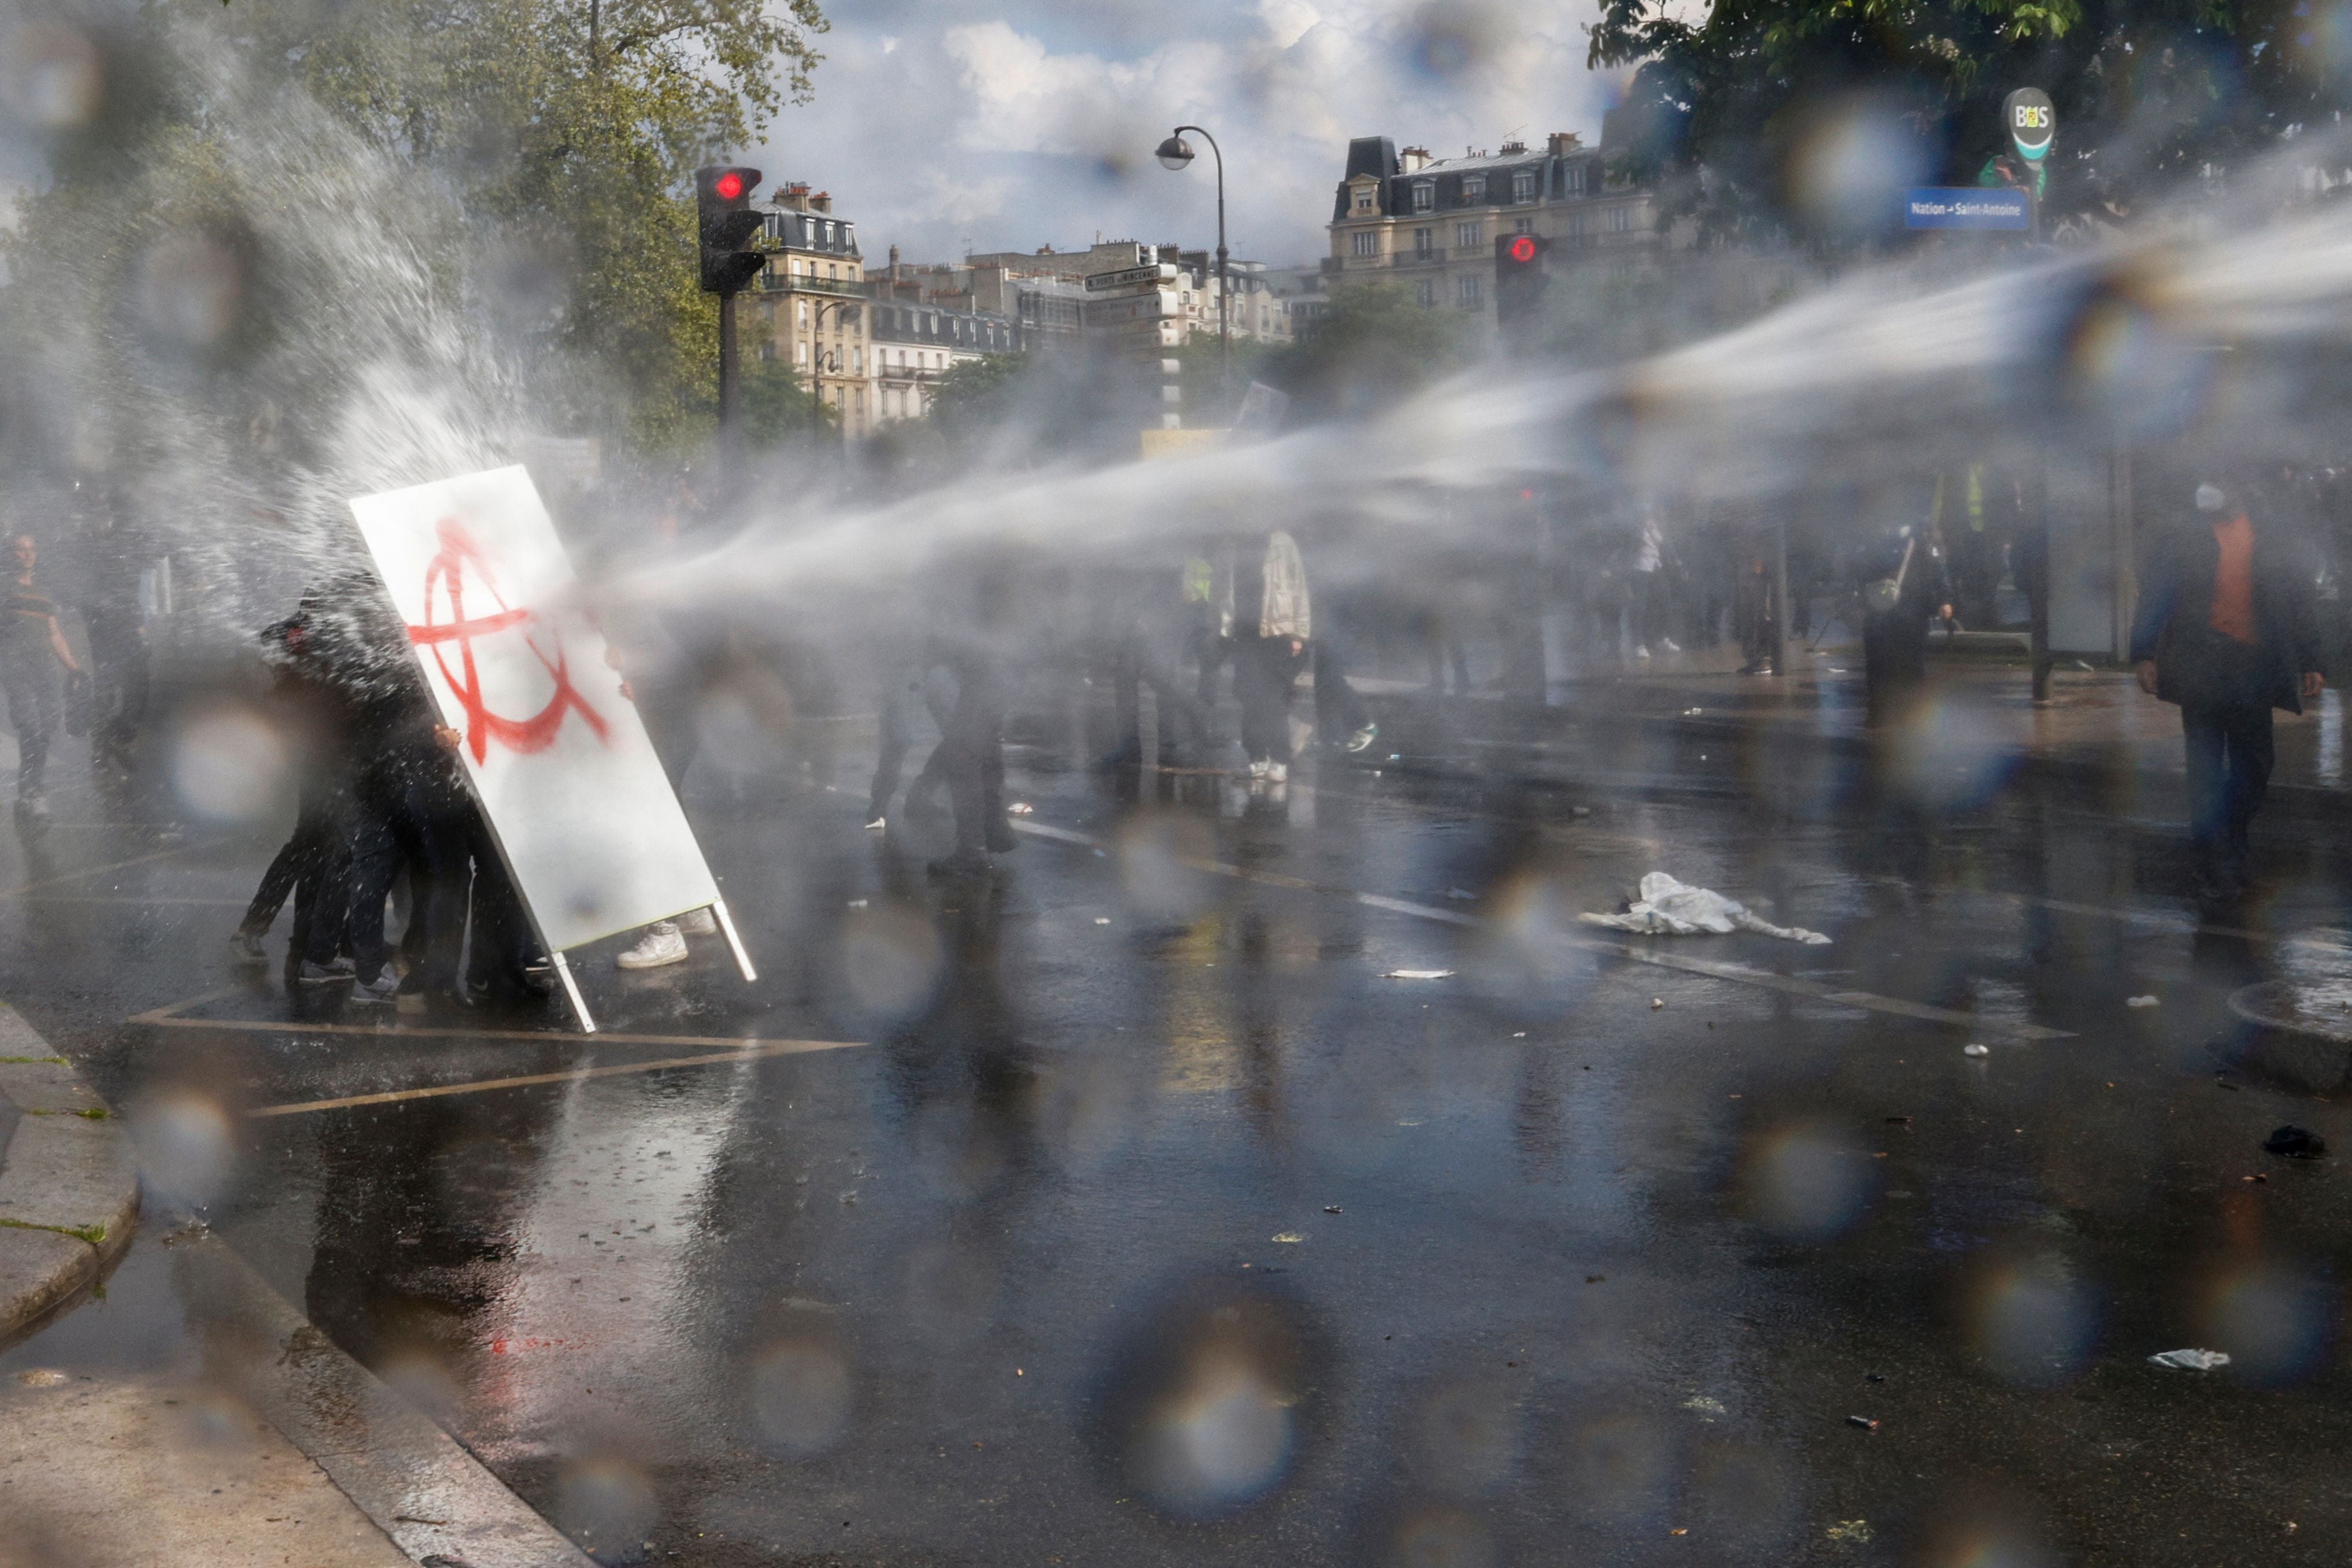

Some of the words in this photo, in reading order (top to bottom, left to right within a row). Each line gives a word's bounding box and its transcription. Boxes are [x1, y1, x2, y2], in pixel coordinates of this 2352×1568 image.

[2016, 106, 2048, 128] BS
[1911, 202, 1945, 215] Nation
[1955, 202, 2021, 216] Saint-Antoine
[1123, 268, 1159, 281] VINCENNES
